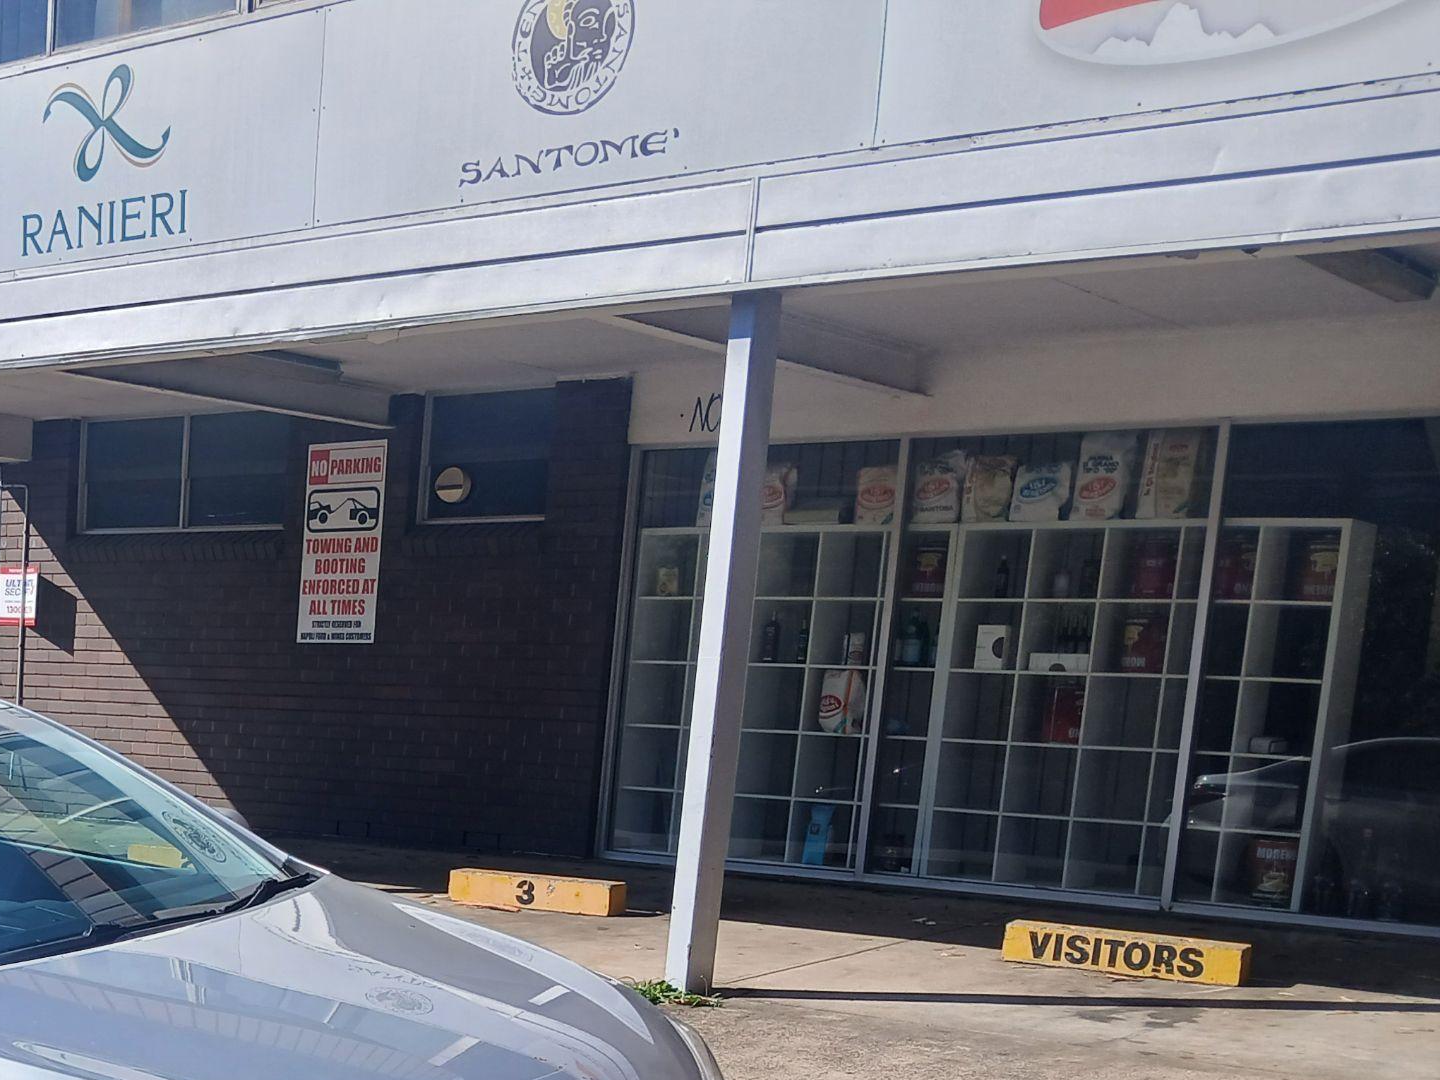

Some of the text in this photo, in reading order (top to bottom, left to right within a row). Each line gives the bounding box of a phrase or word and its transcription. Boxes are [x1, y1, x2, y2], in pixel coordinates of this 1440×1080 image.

[21, 189, 188, 257] RANIERI
[311, 456, 382, 477] NO PARKING
[305, 536, 379, 554] TOWING AND
[314, 558, 366, 575] BOOTING
[301, 578, 377, 596] ENFORCED AT
[308, 599, 366, 616] ALL TIMES
[515, 879, 536, 906] 3
[1028, 931, 1205, 979] VISITORS
